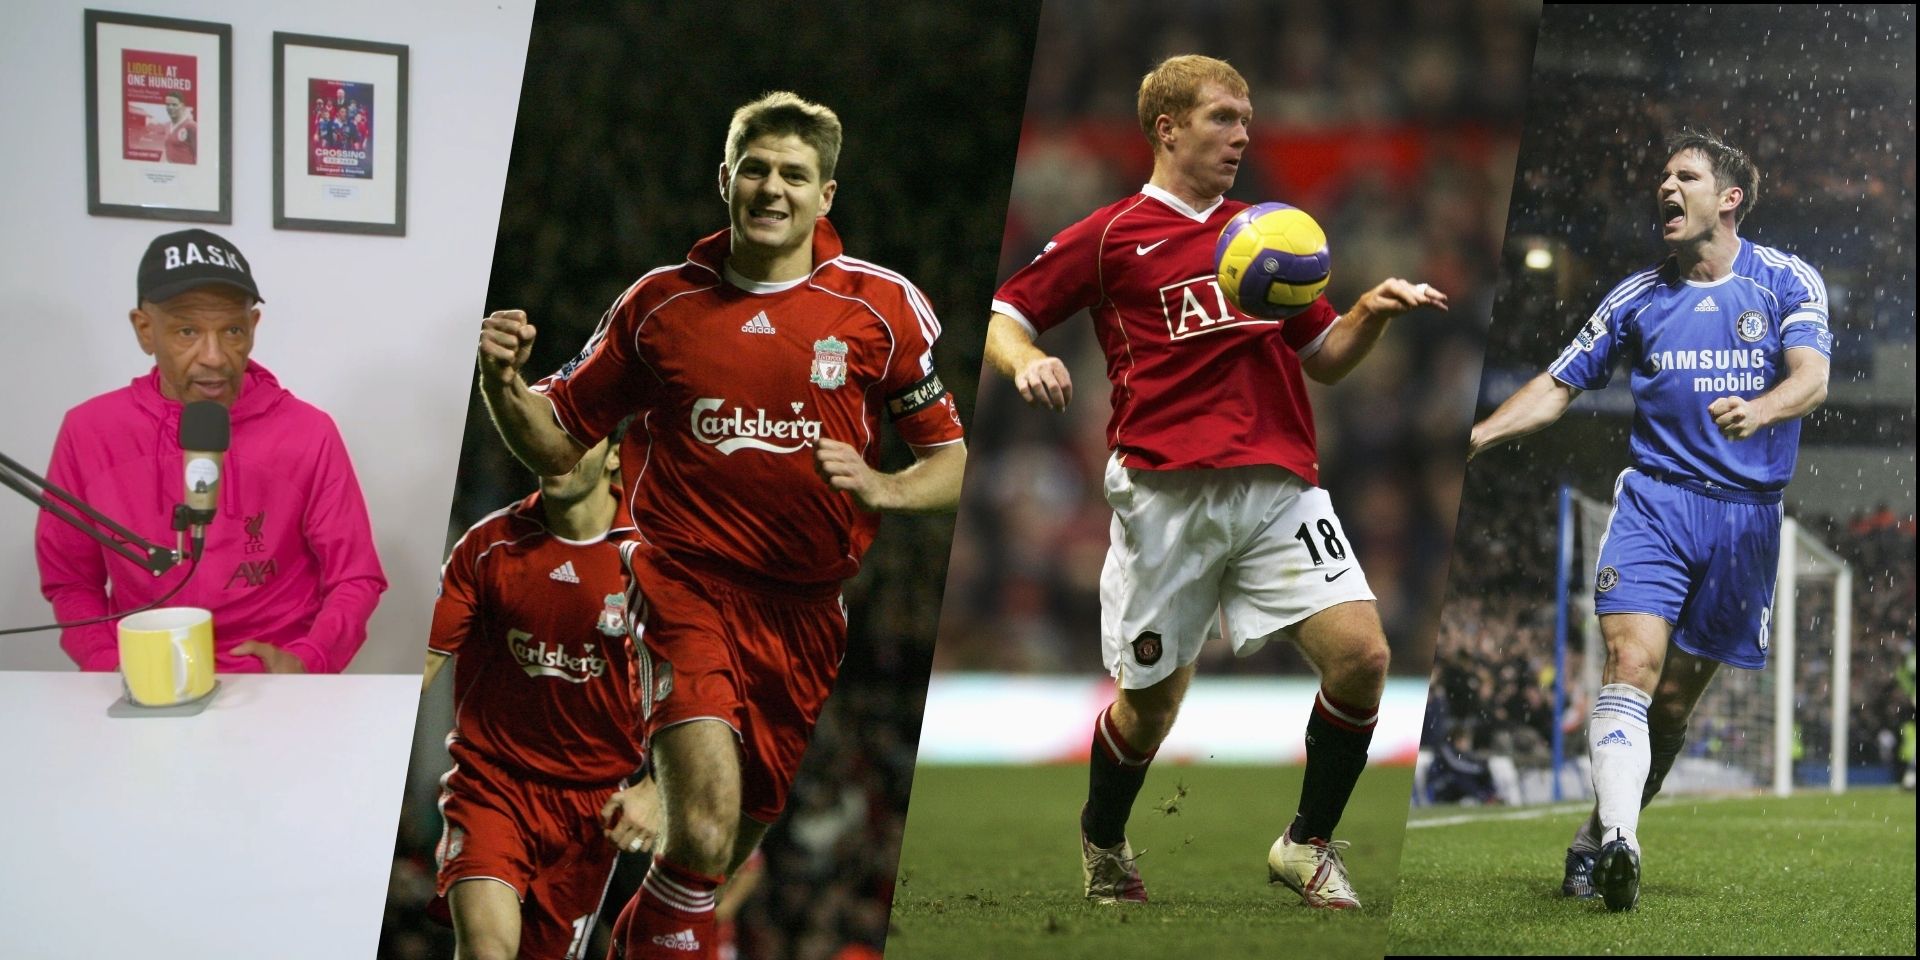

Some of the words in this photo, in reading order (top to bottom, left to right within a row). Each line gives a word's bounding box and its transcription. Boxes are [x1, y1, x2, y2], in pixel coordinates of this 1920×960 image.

[127, 61, 164, 77] LIDDELL
[166, 65, 178, 78] AT
[127, 74, 146, 87] ONE
[148, 76, 192, 91] HUNDRED
[315, 148, 367, 160] CROSSING
[1177, 281, 1240, 334] AI
[741, 325, 776, 335] adidas
[1651, 348, 1765, 372] SAMSUNG
[1694, 372, 1765, 392] mobile
[691, 398, 823, 447] Carlsberg
[1295, 518, 1346, 567] 18
[224, 558, 278, 590] AXA
[1759, 607, 1770, 650] 8
[507, 628, 606, 678] Carlsberg
[651, 934, 700, 951] adidas
